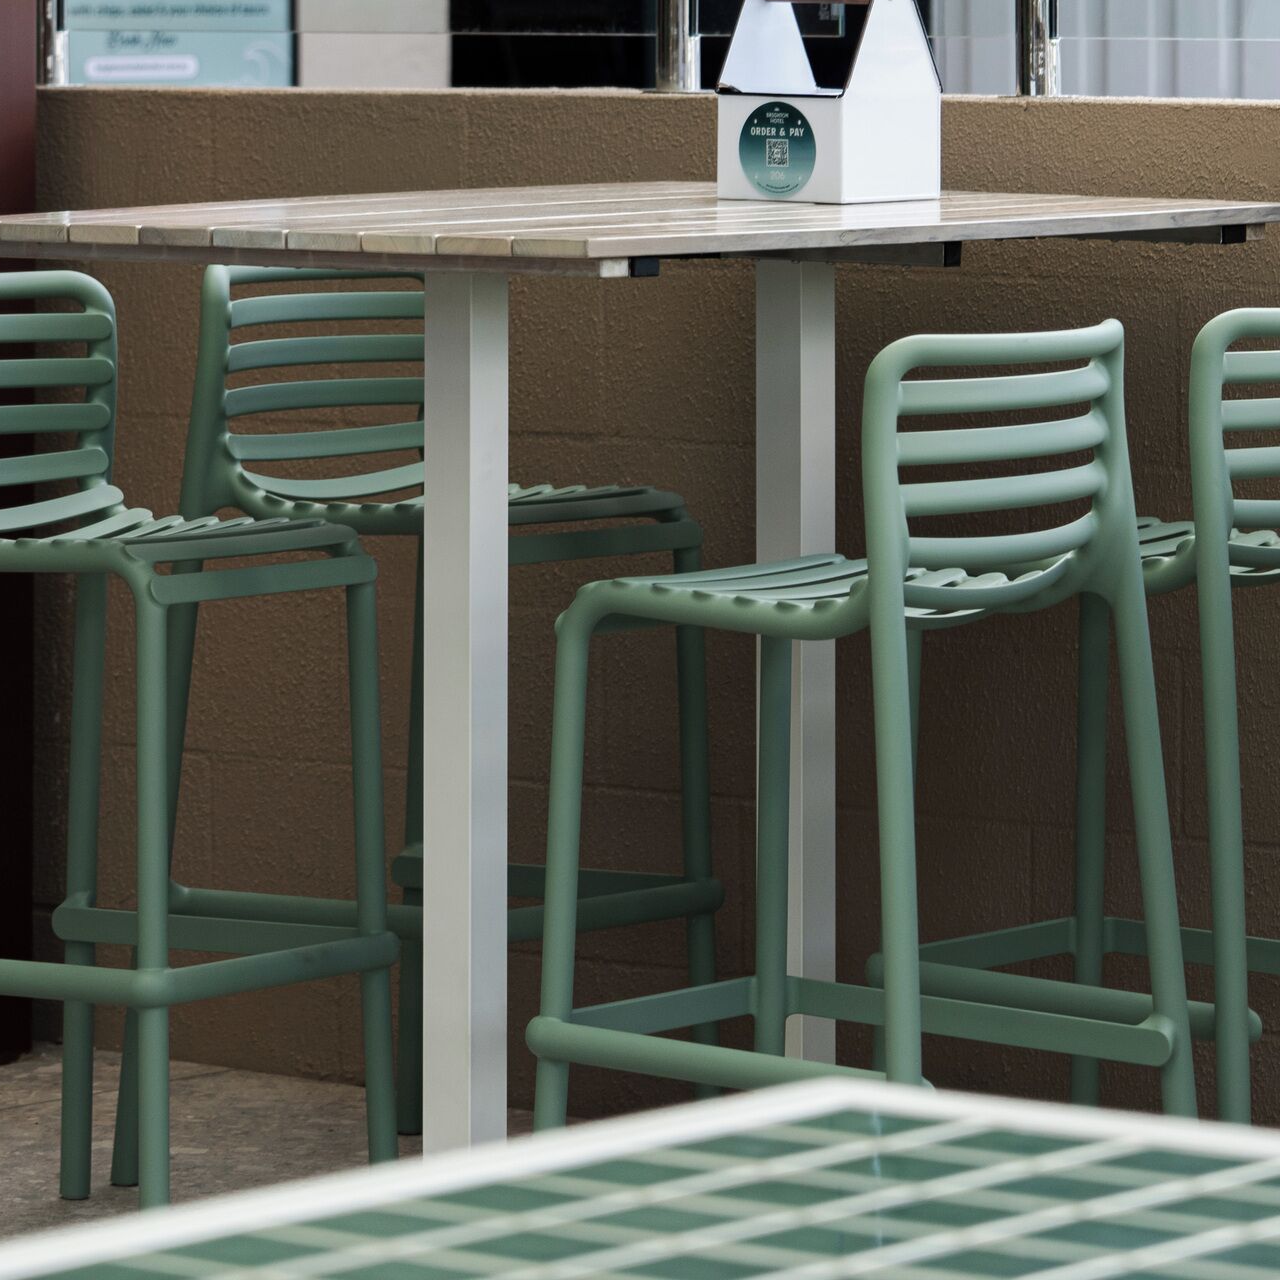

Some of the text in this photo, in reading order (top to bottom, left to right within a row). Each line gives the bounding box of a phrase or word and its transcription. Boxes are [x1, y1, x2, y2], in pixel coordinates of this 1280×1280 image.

[750, 126, 805, 137] ORDER & PAY
